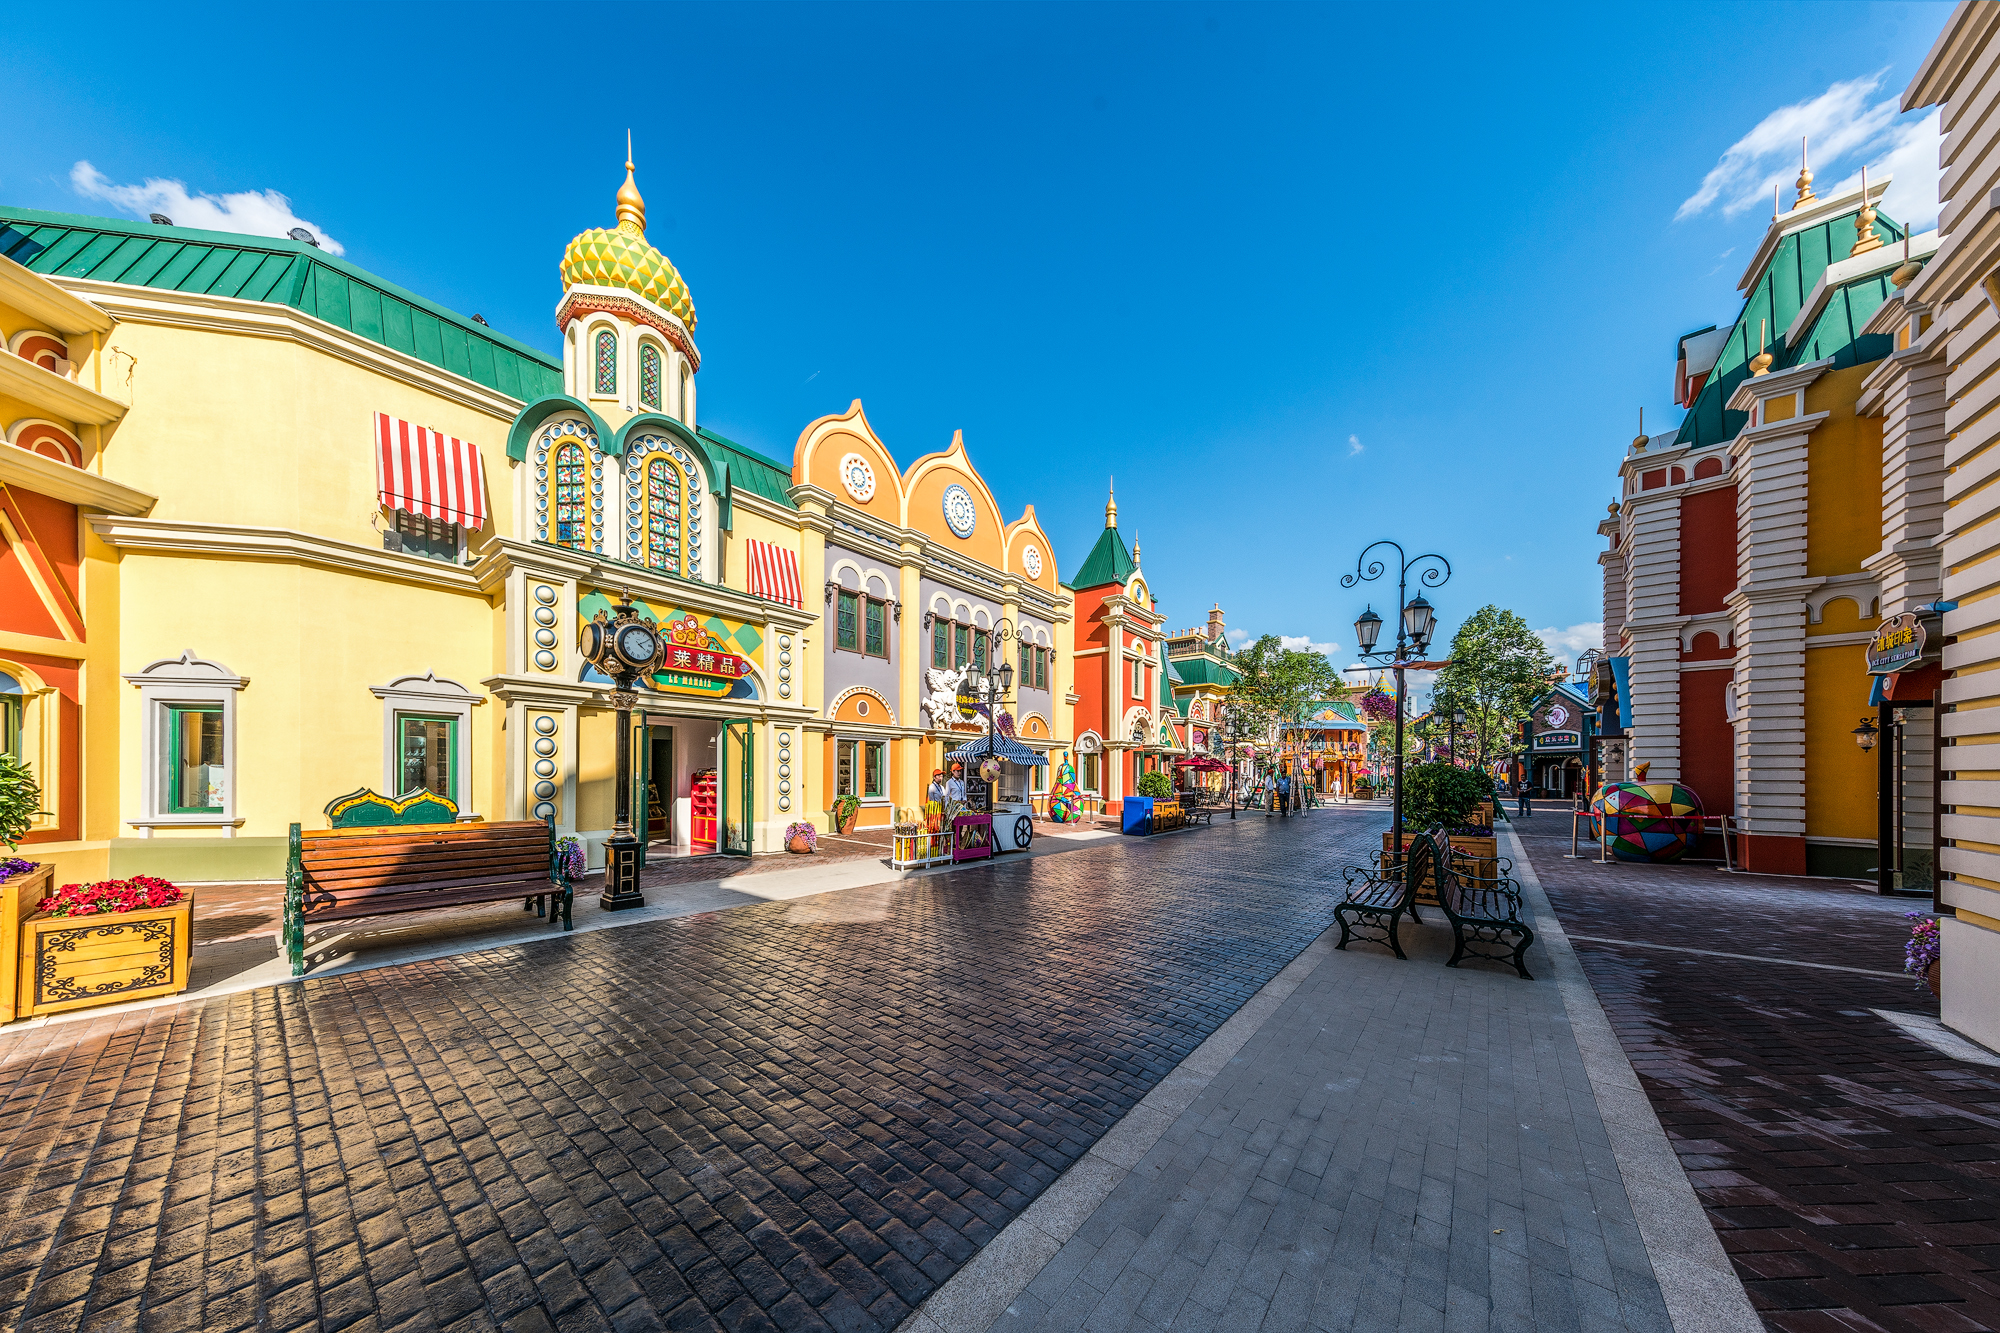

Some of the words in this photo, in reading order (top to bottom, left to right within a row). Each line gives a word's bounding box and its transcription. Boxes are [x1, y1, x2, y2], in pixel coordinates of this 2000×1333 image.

[673, 649, 735, 674] 莱精品
[1880, 656, 1890, 665] CITY
[669, 674, 678, 684] LE
